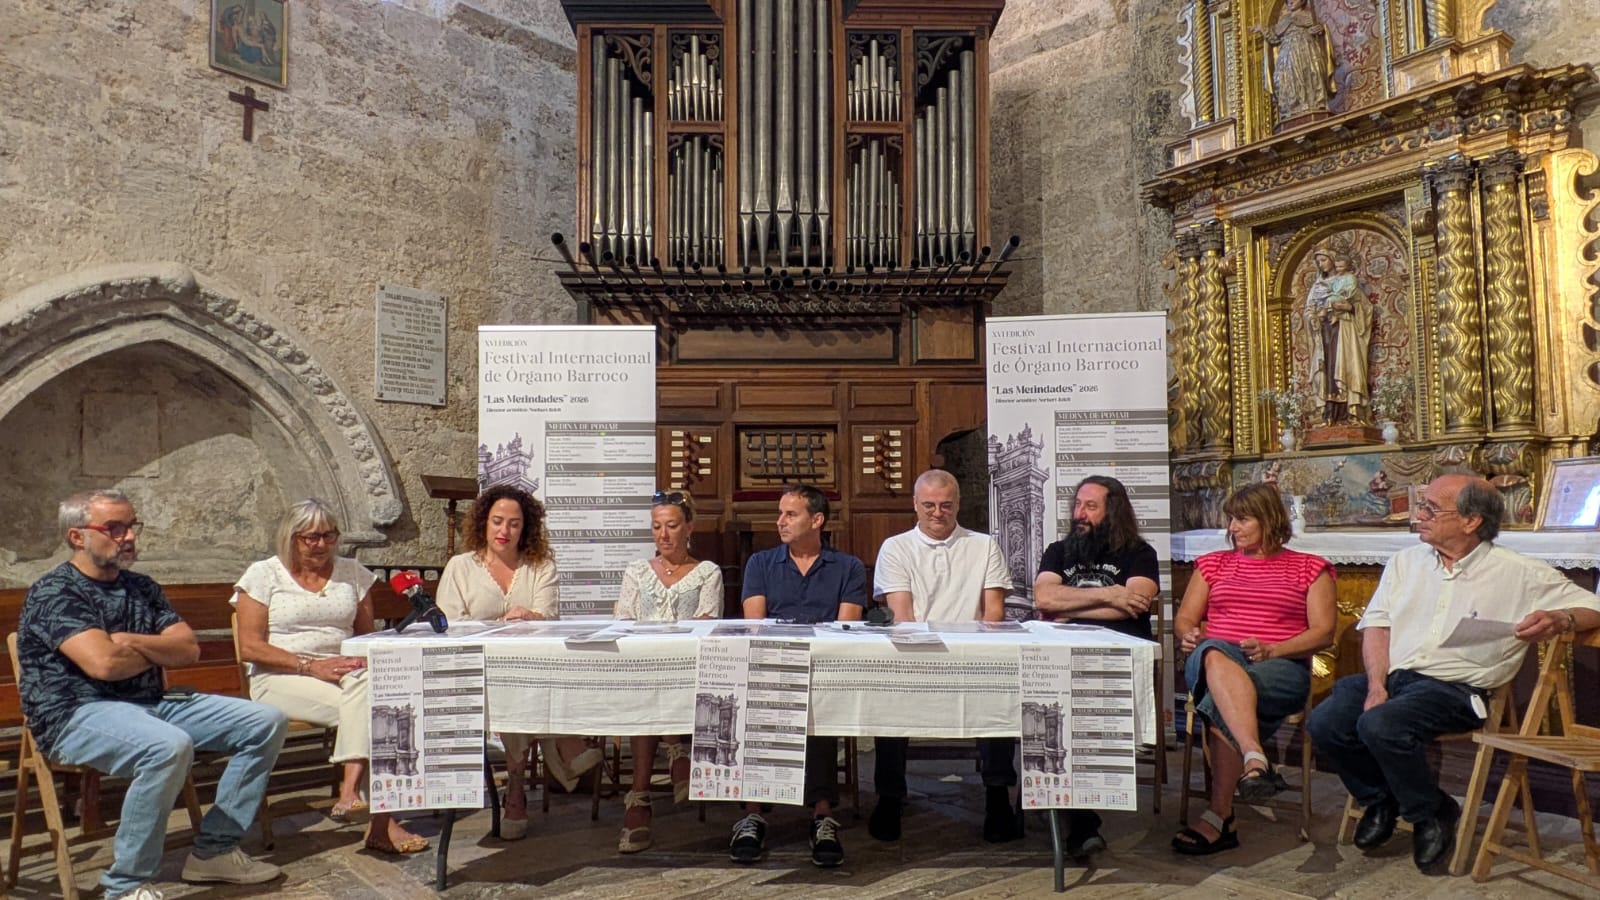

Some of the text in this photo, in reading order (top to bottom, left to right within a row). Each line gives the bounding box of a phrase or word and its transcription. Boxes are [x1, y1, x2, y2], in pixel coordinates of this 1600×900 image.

[993, 338, 1163, 355] Festival Internacional
[485, 351, 651, 365] Festival Internacional
[993, 357, 1139, 376] de Órgano Barroco
[484, 367, 629, 385] de Órgano Barroco
[1079, 385, 1099, 393] 2026
[570, 396, 589, 404] 2026
[1101, 411, 1129, 419] POMAR
[700, 645, 728, 653] Festival
[372, 657, 402, 665] Festival
[699, 654, 748, 663] Internacional
[1022, 654, 1050, 662] Festival
[372, 665, 421, 673] Internacional
[1022, 663, 1070, 671] Internacional
[699, 671, 728, 679] Barroco
